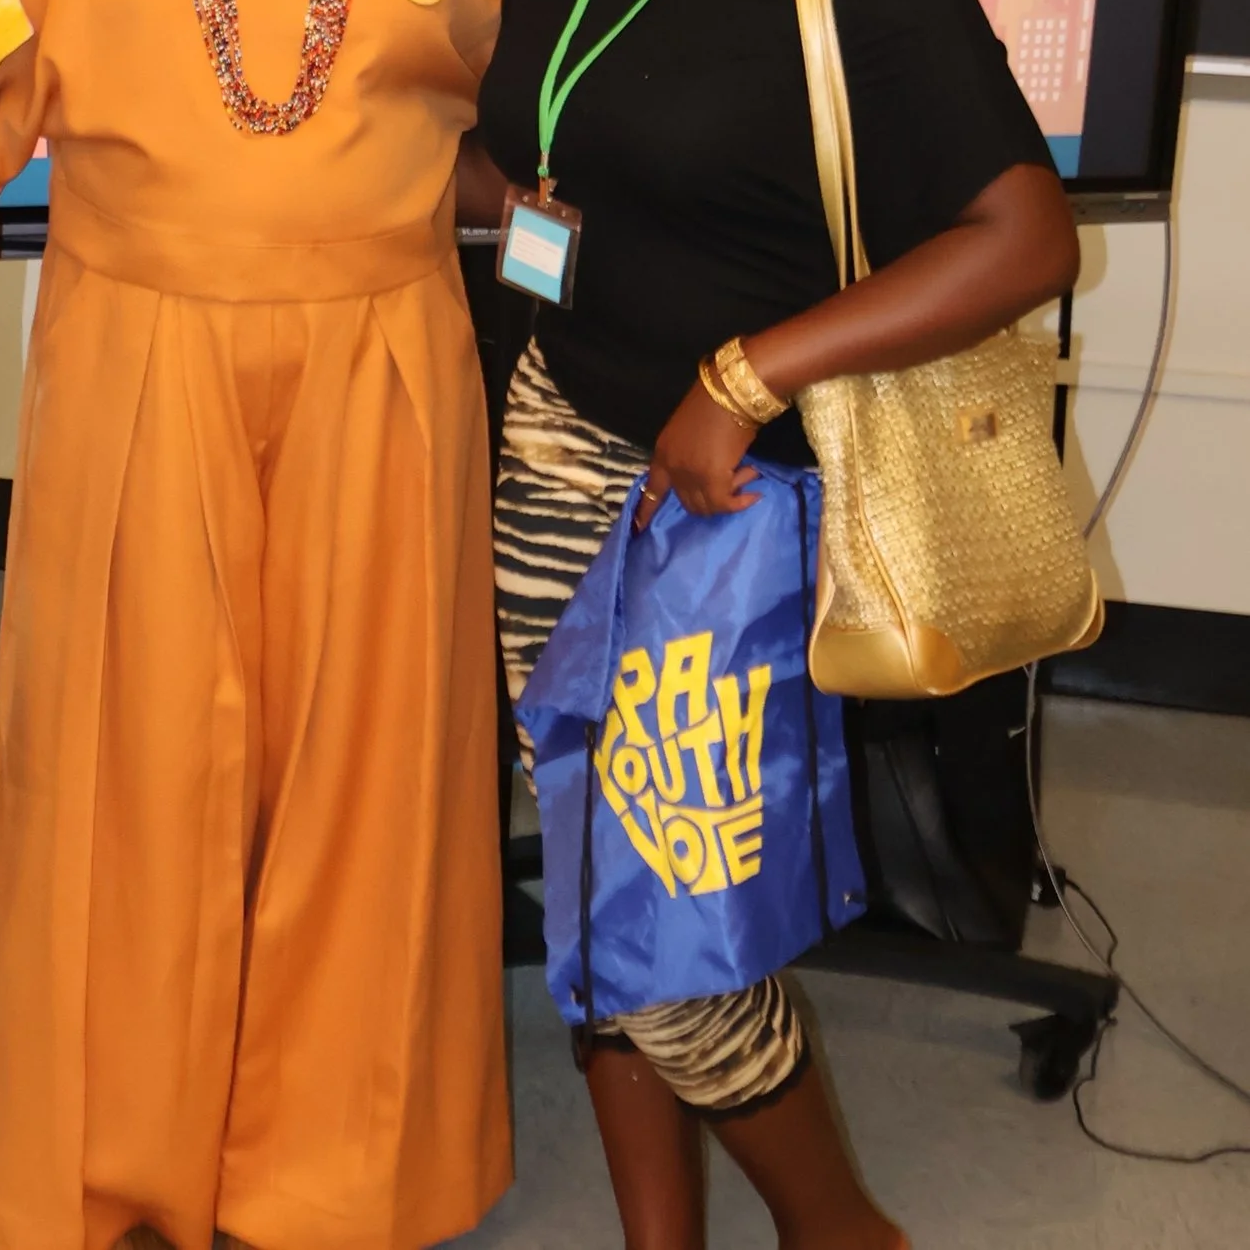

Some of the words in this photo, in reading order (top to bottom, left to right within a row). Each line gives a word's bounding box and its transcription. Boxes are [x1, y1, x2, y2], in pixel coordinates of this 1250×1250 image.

[592, 663, 772, 818] YOUTH
[612, 629, 714, 749] PA
[618, 788, 763, 900] VOTE
